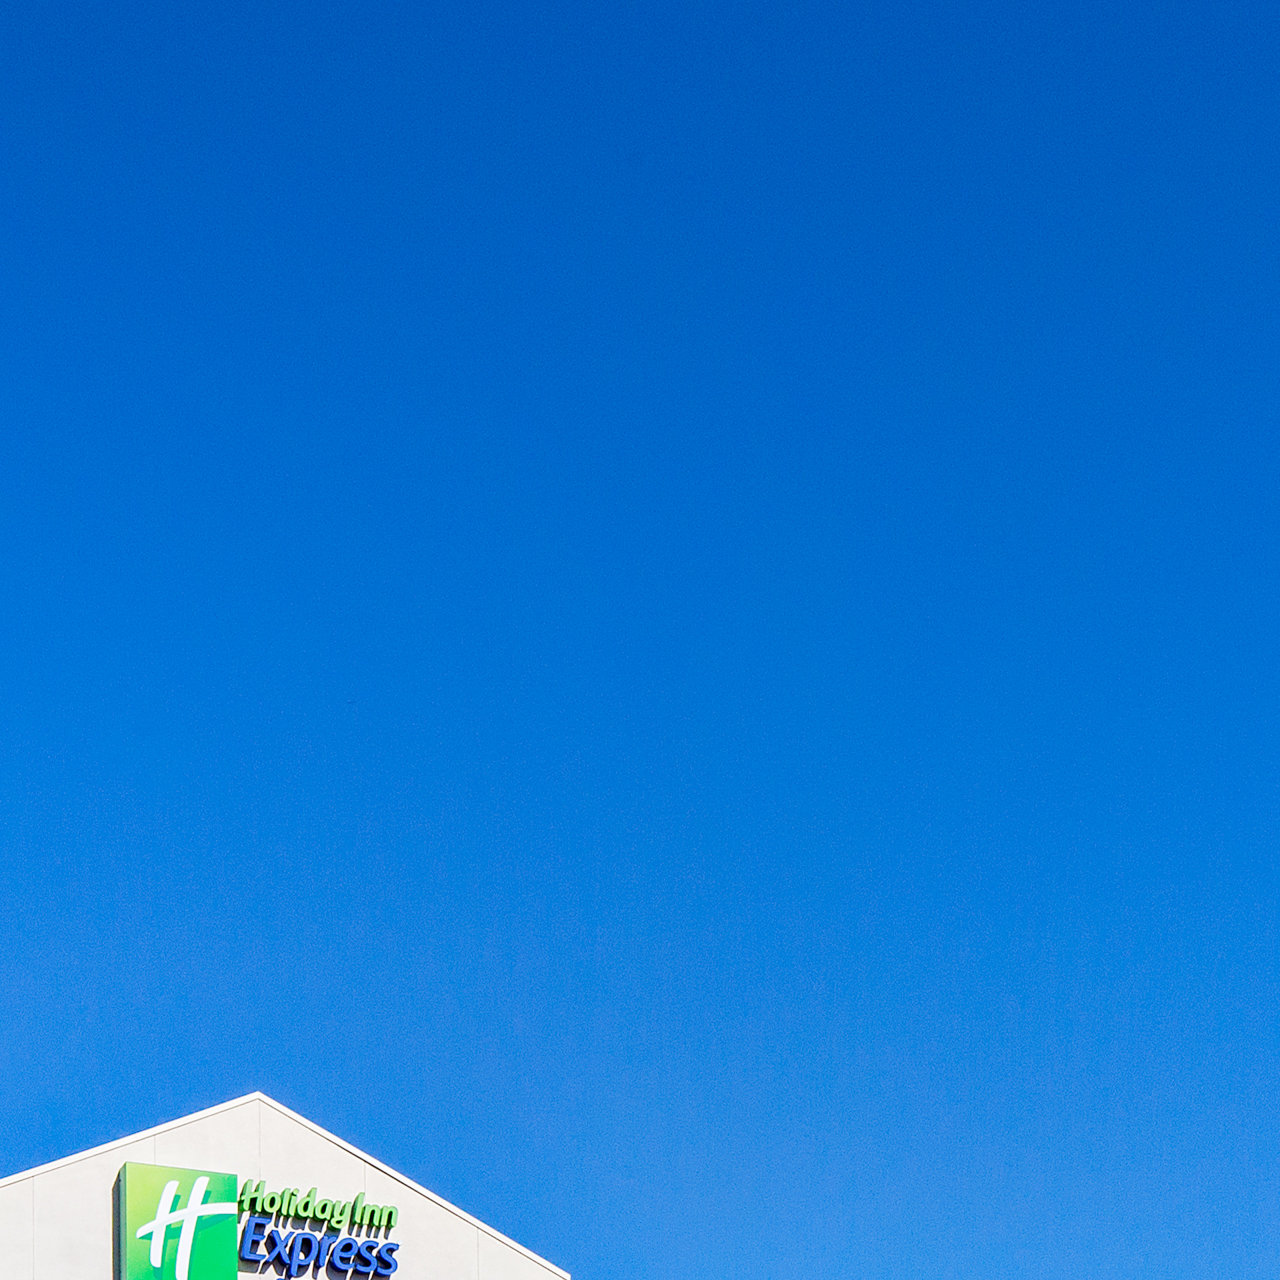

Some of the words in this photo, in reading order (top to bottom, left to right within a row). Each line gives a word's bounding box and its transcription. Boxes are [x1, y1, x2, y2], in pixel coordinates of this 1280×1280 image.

[238, 1179, 351, 1230] Holiday
[351, 1192, 398, 1228] Inn
[240, 1216, 400, 1277] Express
